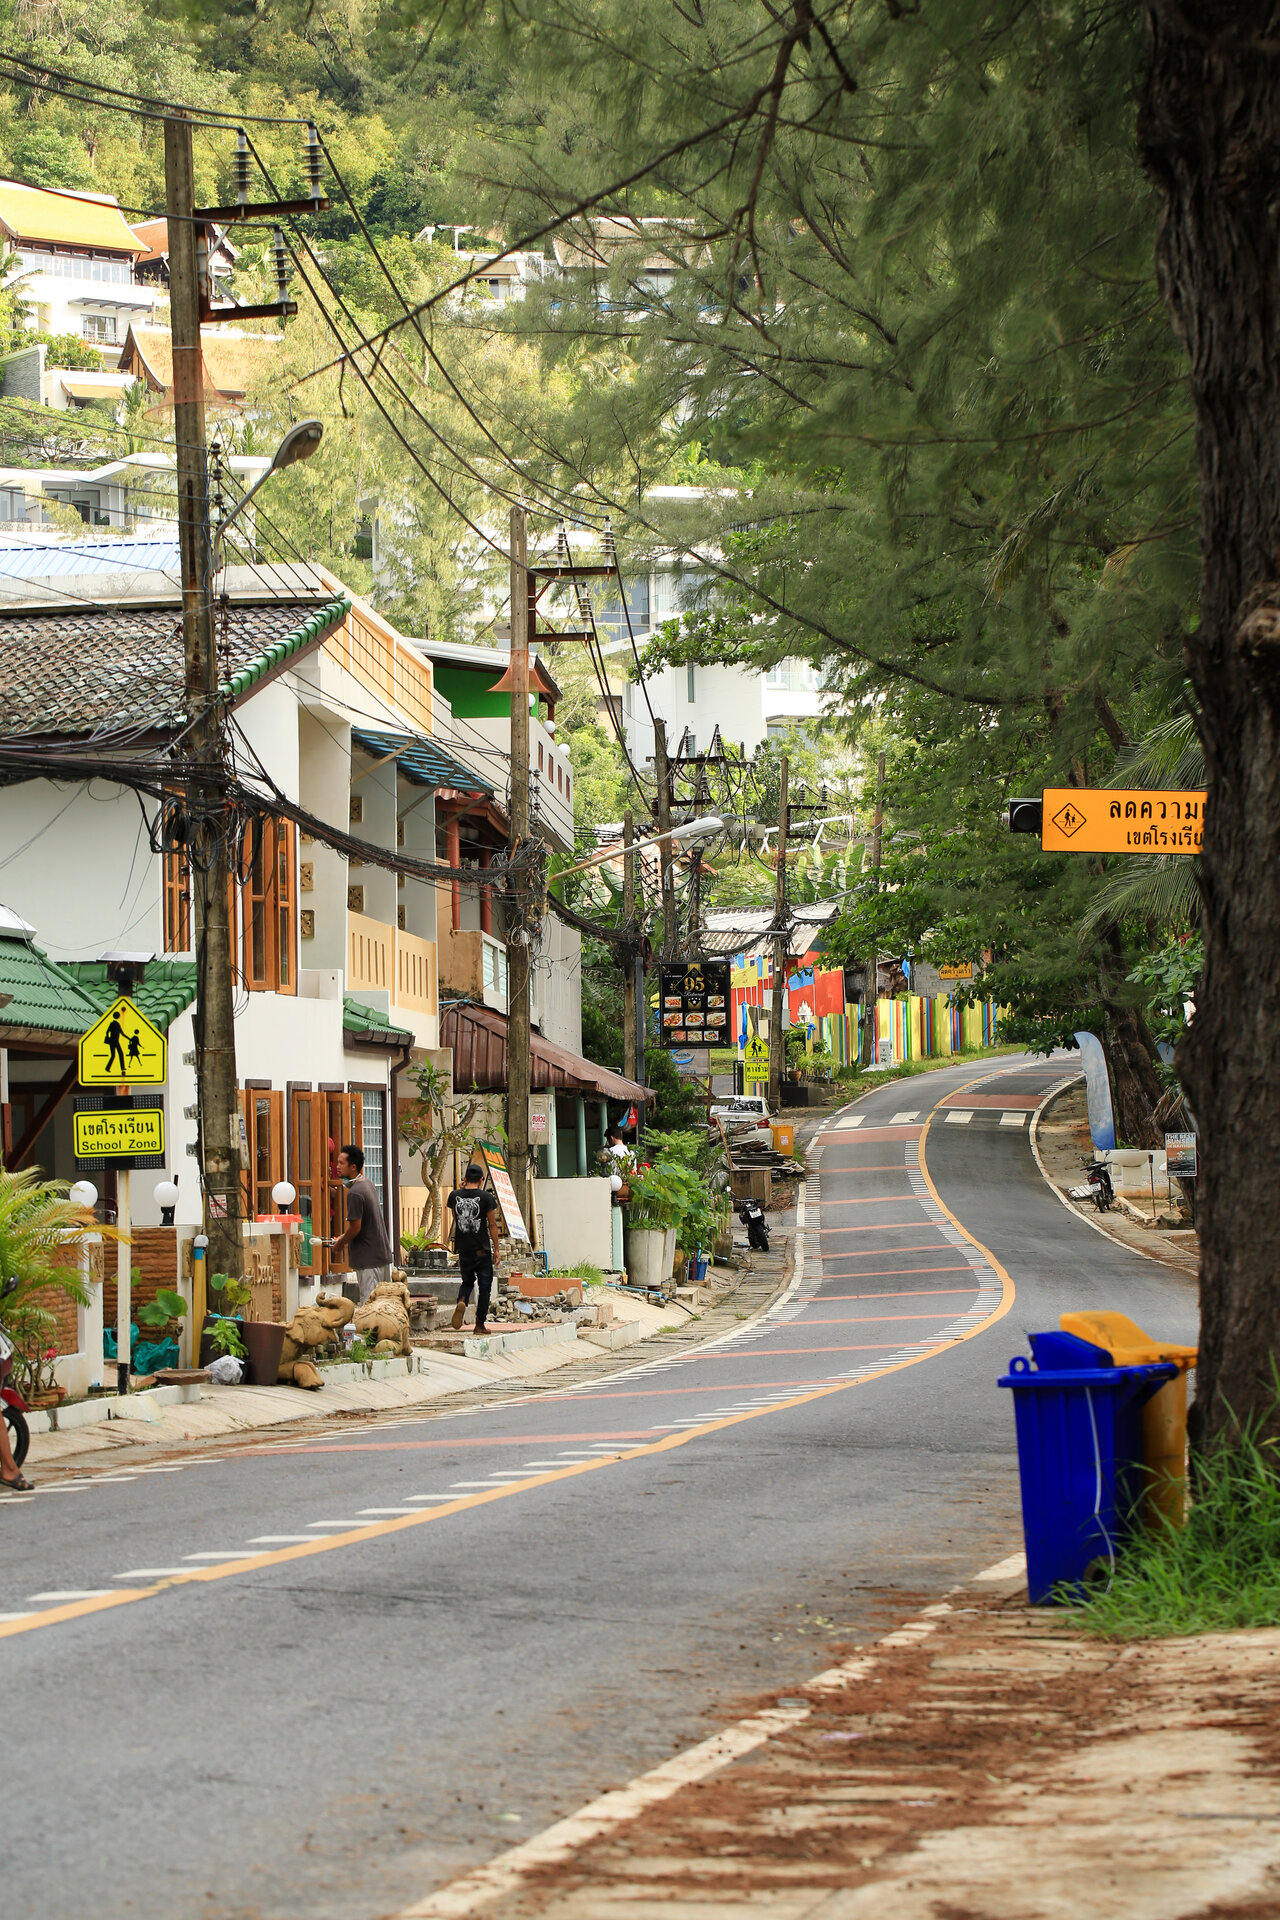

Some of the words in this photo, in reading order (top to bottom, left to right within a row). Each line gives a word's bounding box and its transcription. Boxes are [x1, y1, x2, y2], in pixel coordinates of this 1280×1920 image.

[684, 977, 705, 992] 95
[746, 1064, 768, 1073] ทางข้าม
[83, 1117, 154, 1136] เขตโรงเรียน
[82, 1140, 121, 1151] School
[129, 1138, 157, 1149] Zone
